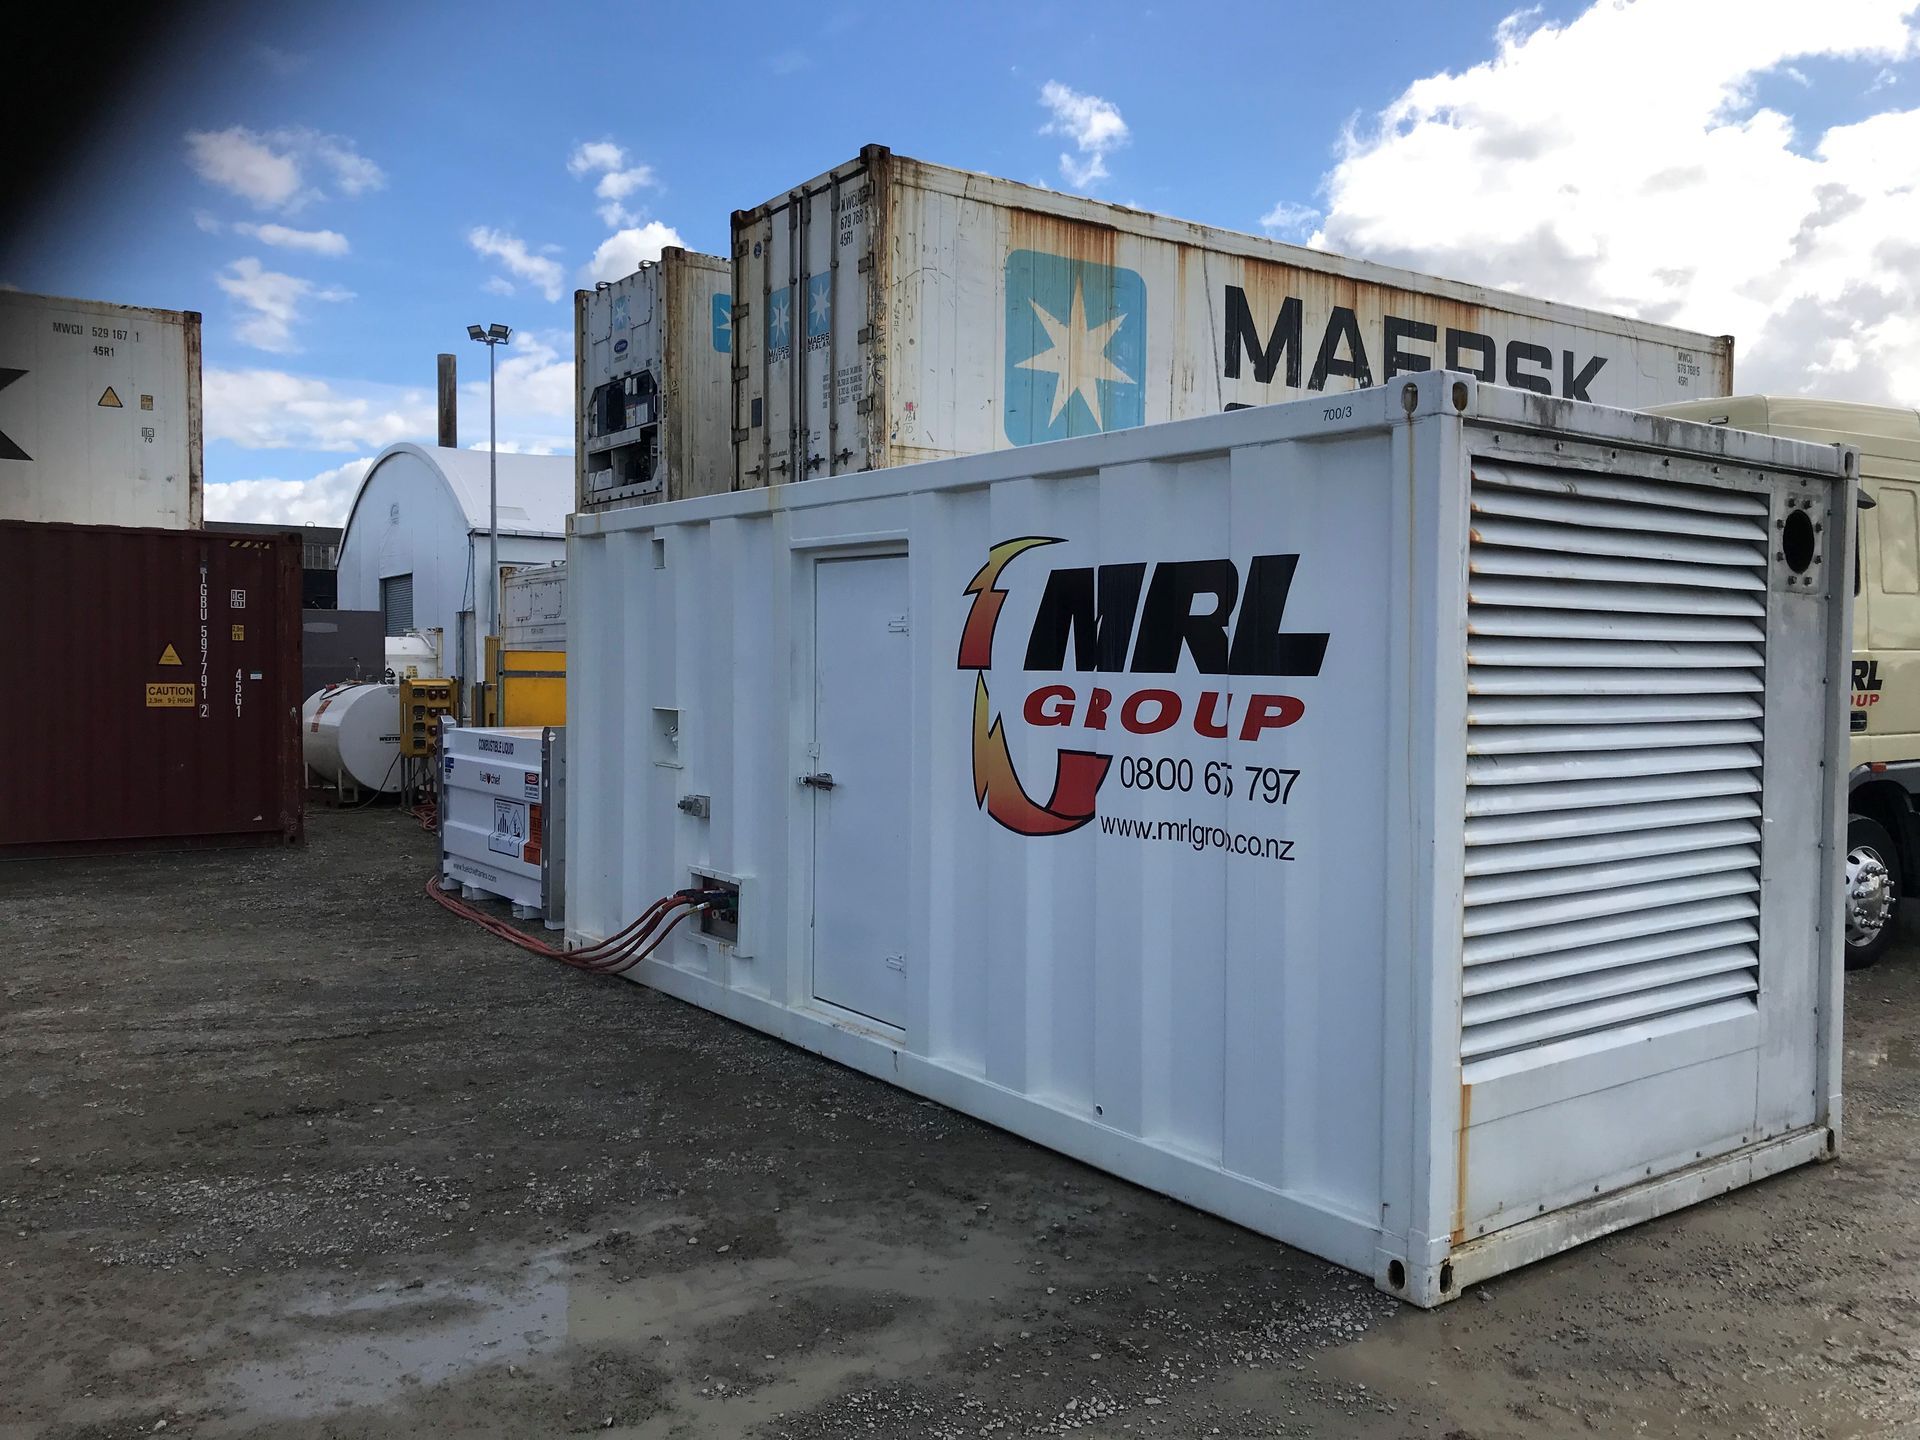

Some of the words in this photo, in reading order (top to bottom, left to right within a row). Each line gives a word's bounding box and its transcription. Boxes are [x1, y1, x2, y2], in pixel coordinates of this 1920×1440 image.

[840, 213, 852, 230] 679
[840, 230, 854, 247] 45R1
[52, 322, 83, 335] MWCU
[92, 327, 109, 338] 529
[113, 329, 128, 341] 167
[136, 331, 140, 342] 1
[807, 332, 830, 346] MAERS
[93, 345, 115, 357] 45R1
[1224, 285, 1609, 404] MAERSK
[1322, 405, 1353, 422] 700/3
[200, 573, 208, 621] TGBU
[1023, 554, 1330, 677] MRL
[200, 625, 208, 700] 597791
[148, 686, 194, 696] CAUTION
[201, 704, 208, 718] 2
[1023, 685, 1306, 742] GROUP
[1120, 756, 1194, 792] 0800
[1245, 766, 1301, 805] 797
